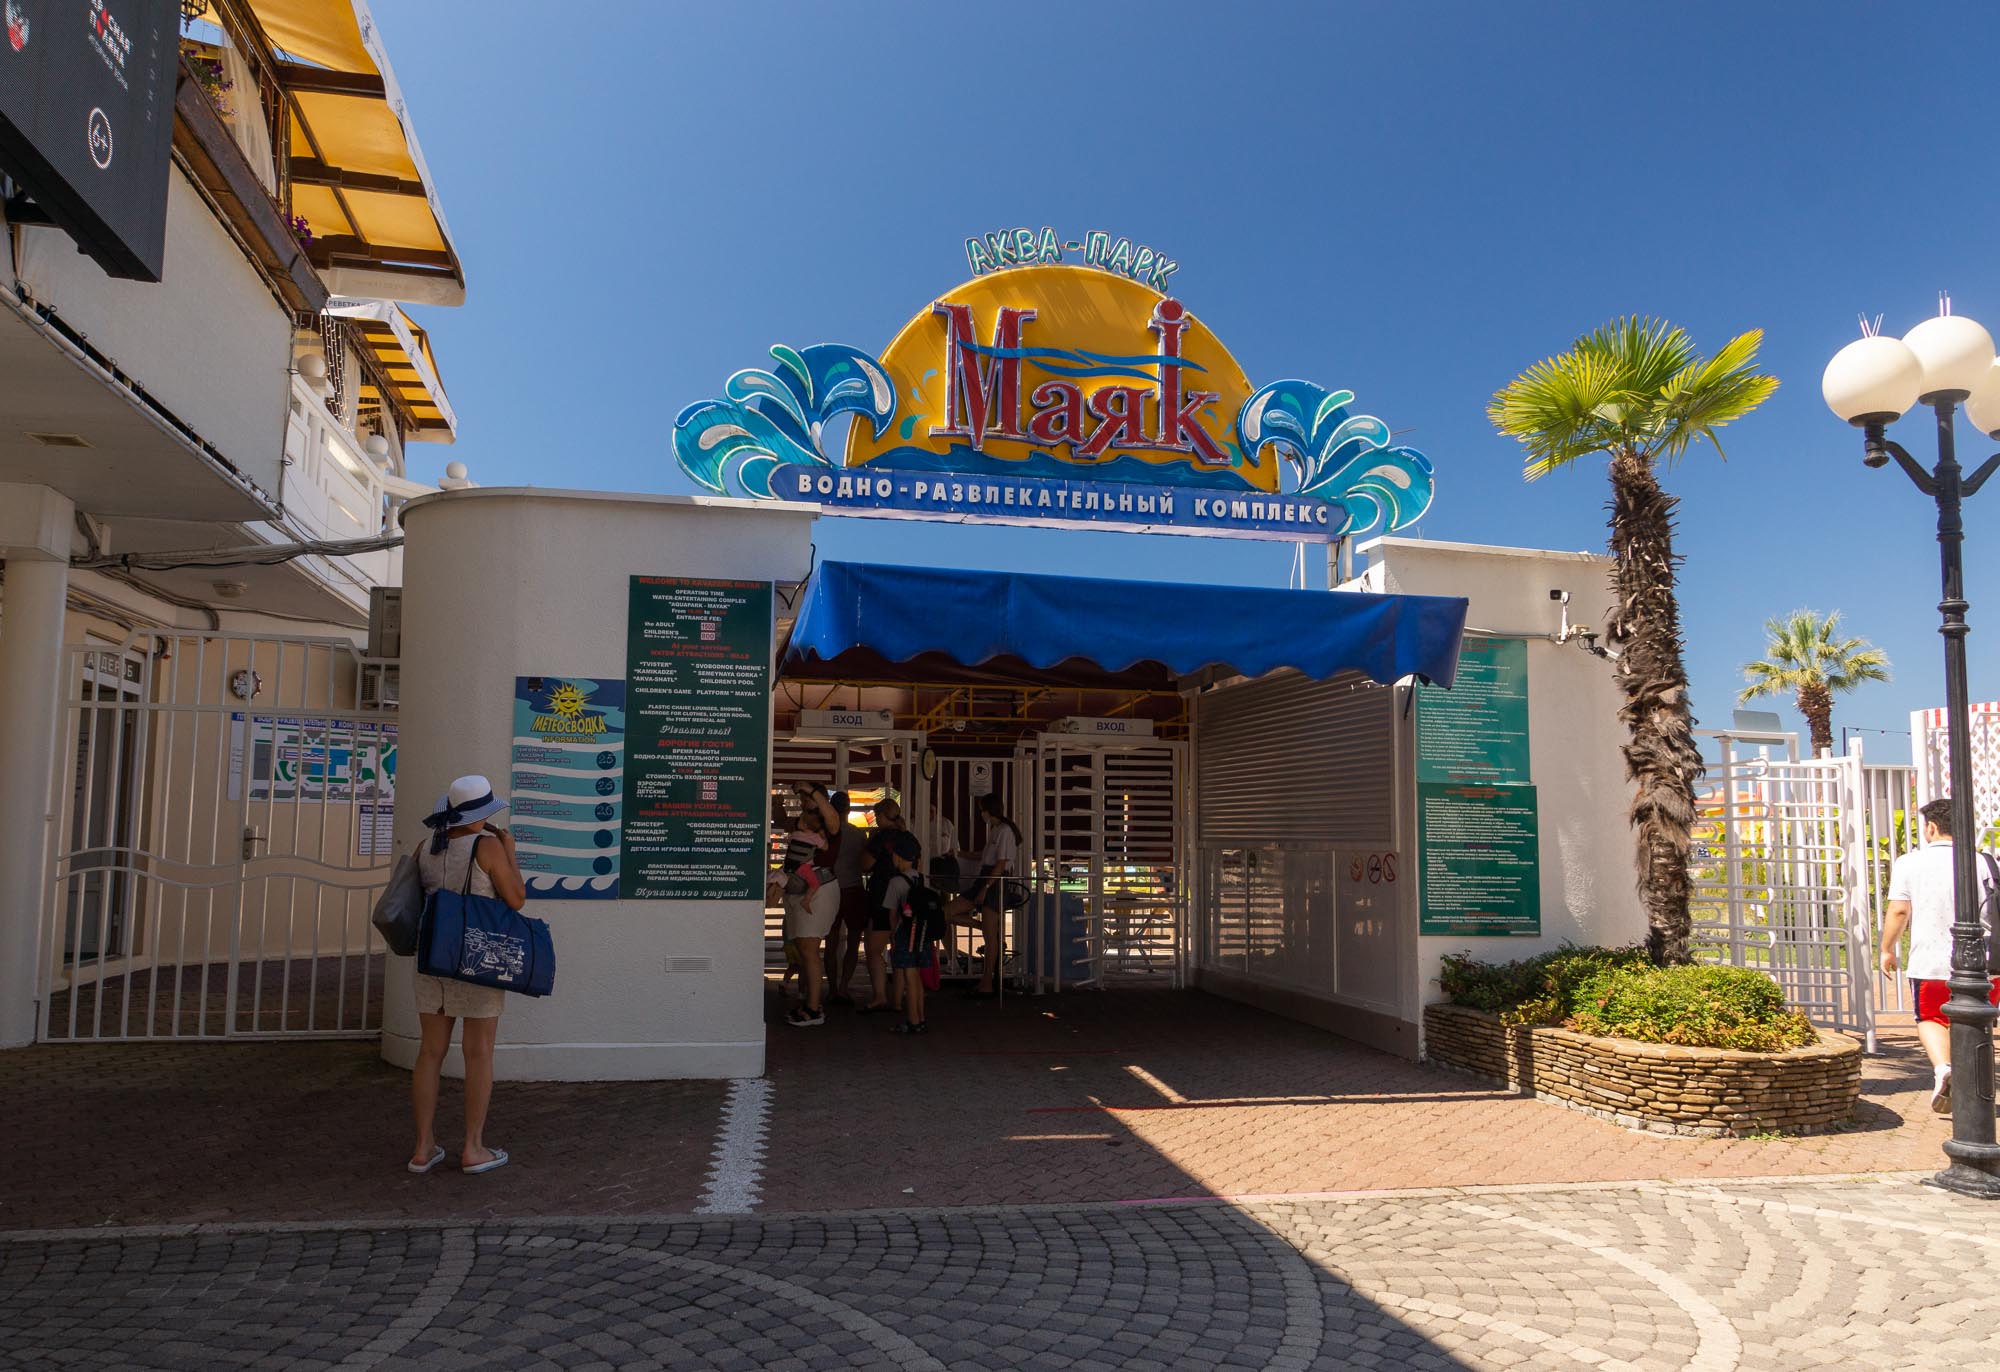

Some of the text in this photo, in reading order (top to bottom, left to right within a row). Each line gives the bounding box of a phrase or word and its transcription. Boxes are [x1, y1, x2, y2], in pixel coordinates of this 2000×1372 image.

[928, 297, 1233, 465] Маяк
[1194, 498, 1328, 525] КОМПЛЕКС
[531, 715, 607, 734] МЕТЕОСВОДКА
[833, 715, 863, 726] ВХОД
[1097, 722, 1125, 731] ВХОД
[542, 736, 596, 744] INFORMATION
